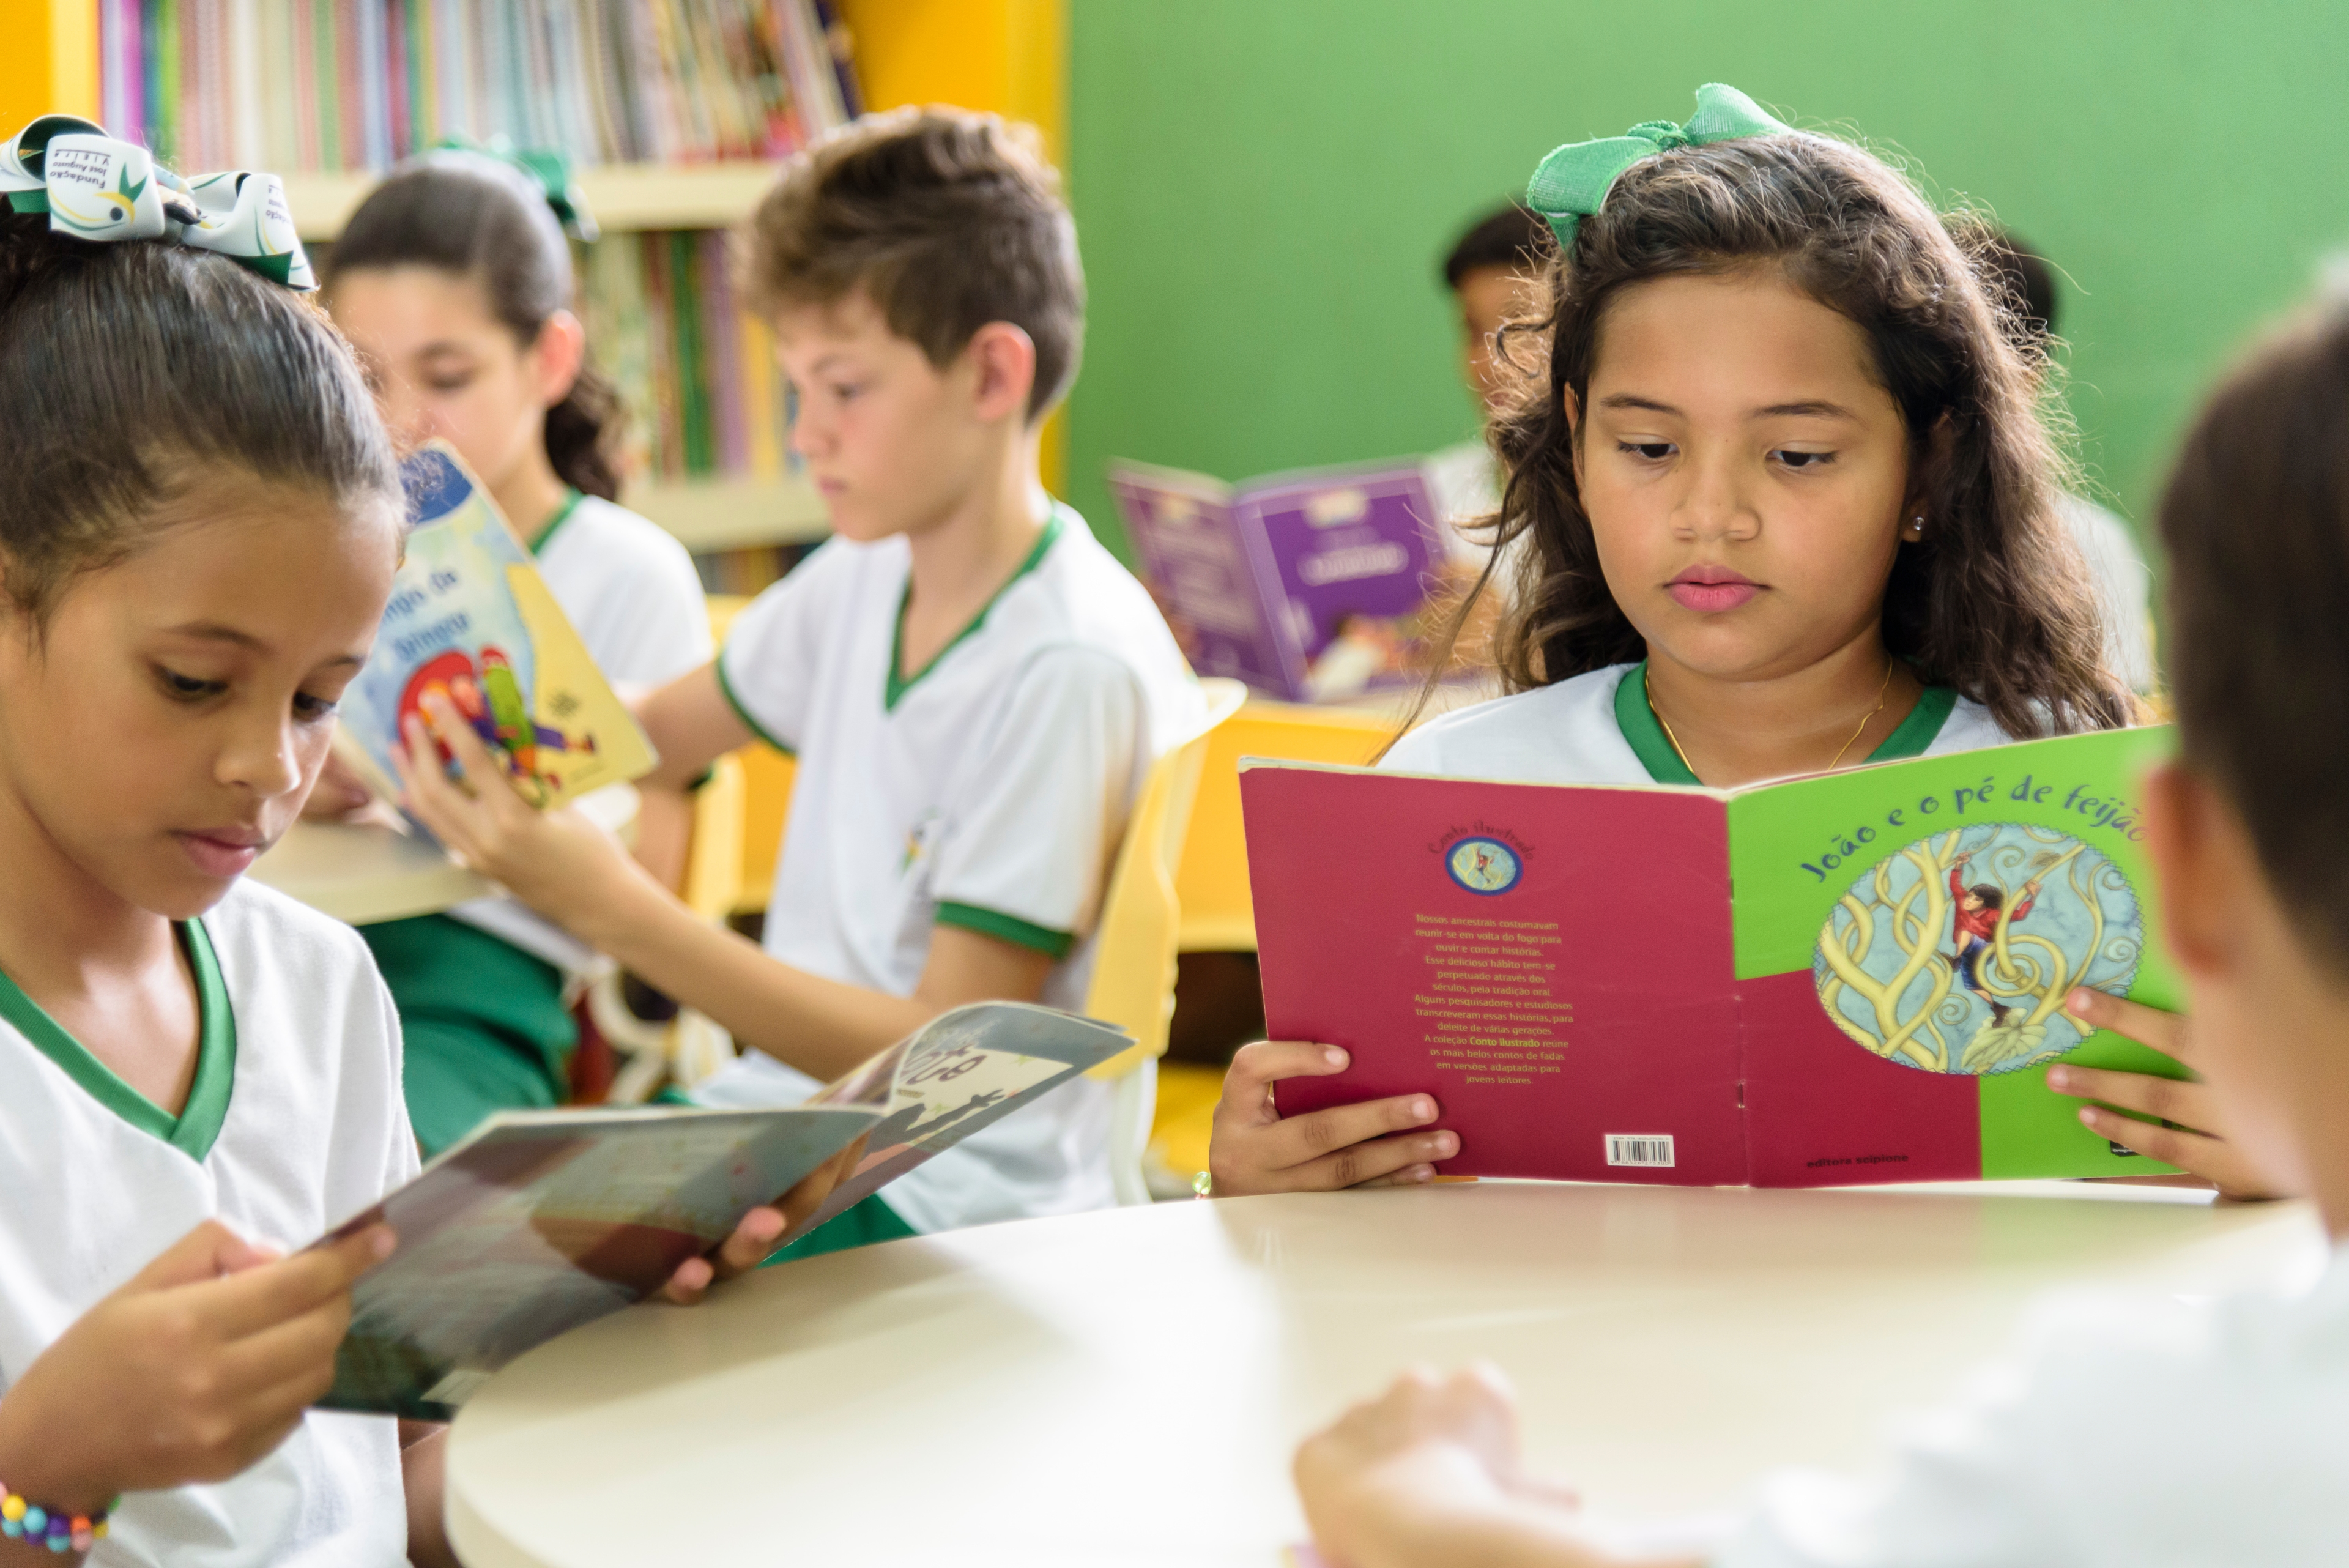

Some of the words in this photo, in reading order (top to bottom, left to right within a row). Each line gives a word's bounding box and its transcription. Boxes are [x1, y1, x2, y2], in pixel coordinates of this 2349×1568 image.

[53, 161, 87, 172] Augusto
[50, 171, 106, 189] Fundação
[1800, 825, 1876, 883] João
[1888, 808, 1906, 826] e
[1920, 796, 1939, 814] o
[1954, 776, 1995, 815] pé
[2010, 774, 2054, 804] de
[2063, 784, 2150, 842] feijão
[1427, 825, 1468, 855] Conto
[1416, 914, 1448, 924] Nossos
[1451, 917, 1496, 927] ancestrais
[1499, 920, 1558, 930] costumavam
[1416, 929, 1457, 938] reunir-se
[1477, 932, 1499, 941] volta
[1502, 933, 1514, 942] do
[1517, 934, 1538, 945] fogo
[1541, 935, 1561, 945] para
[1436, 943, 1459, 953] ouvir
[1471, 946, 1499, 954] contar
[1502, 946, 1544, 956] histórias.
[1425, 956, 1444, 965] Esse
[1448, 957, 1488, 967] delicioso
[1491, 960, 1520, 969] hábito
[1438, 971, 1491, 980] perpetuado
[1494, 973, 1526, 983] através
[1529, 975, 1545, 983] dos
[1433, 983, 1469, 993] séculos,
[1471, 985, 1490, 994] pela
[1493, 987, 1530, 997] tradição
[1415, 994, 1445, 1005] Alguns
[1449, 997, 1513, 1008] pesquisadores
[1524, 1001, 1573, 1010] estudiosos
[1416, 1008, 1480, 1019] transcreveram
[1510, 1013, 1551, 1023] histórias,
[1553, 1015, 1573, 1024] para
[1438, 1022, 1468, 1031] deleite
[1484, 1025, 1510, 1033] várias
[1425, 1034, 1431, 1042] A
[1433, 1035, 1467, 1046] coleção
[1469, 1036, 1497, 1046] Conto
[1543, 1039, 1569, 1048] reúne
[1467, 1050, 1491, 1058] belos
[1526, 1052, 1538, 1060] de
[1540, 1052, 1565, 1060] fadas
[1453, 1063, 1488, 1071] versões
[1490, 1064, 1537, 1074] adaptadas
[1466, 1075, 1495, 1085] jovens
[1498, 1076, 1534, 1085] leitores.
[1806, 1158, 1852, 1168] editora
[1855, 1154, 1909, 1164] scipione
